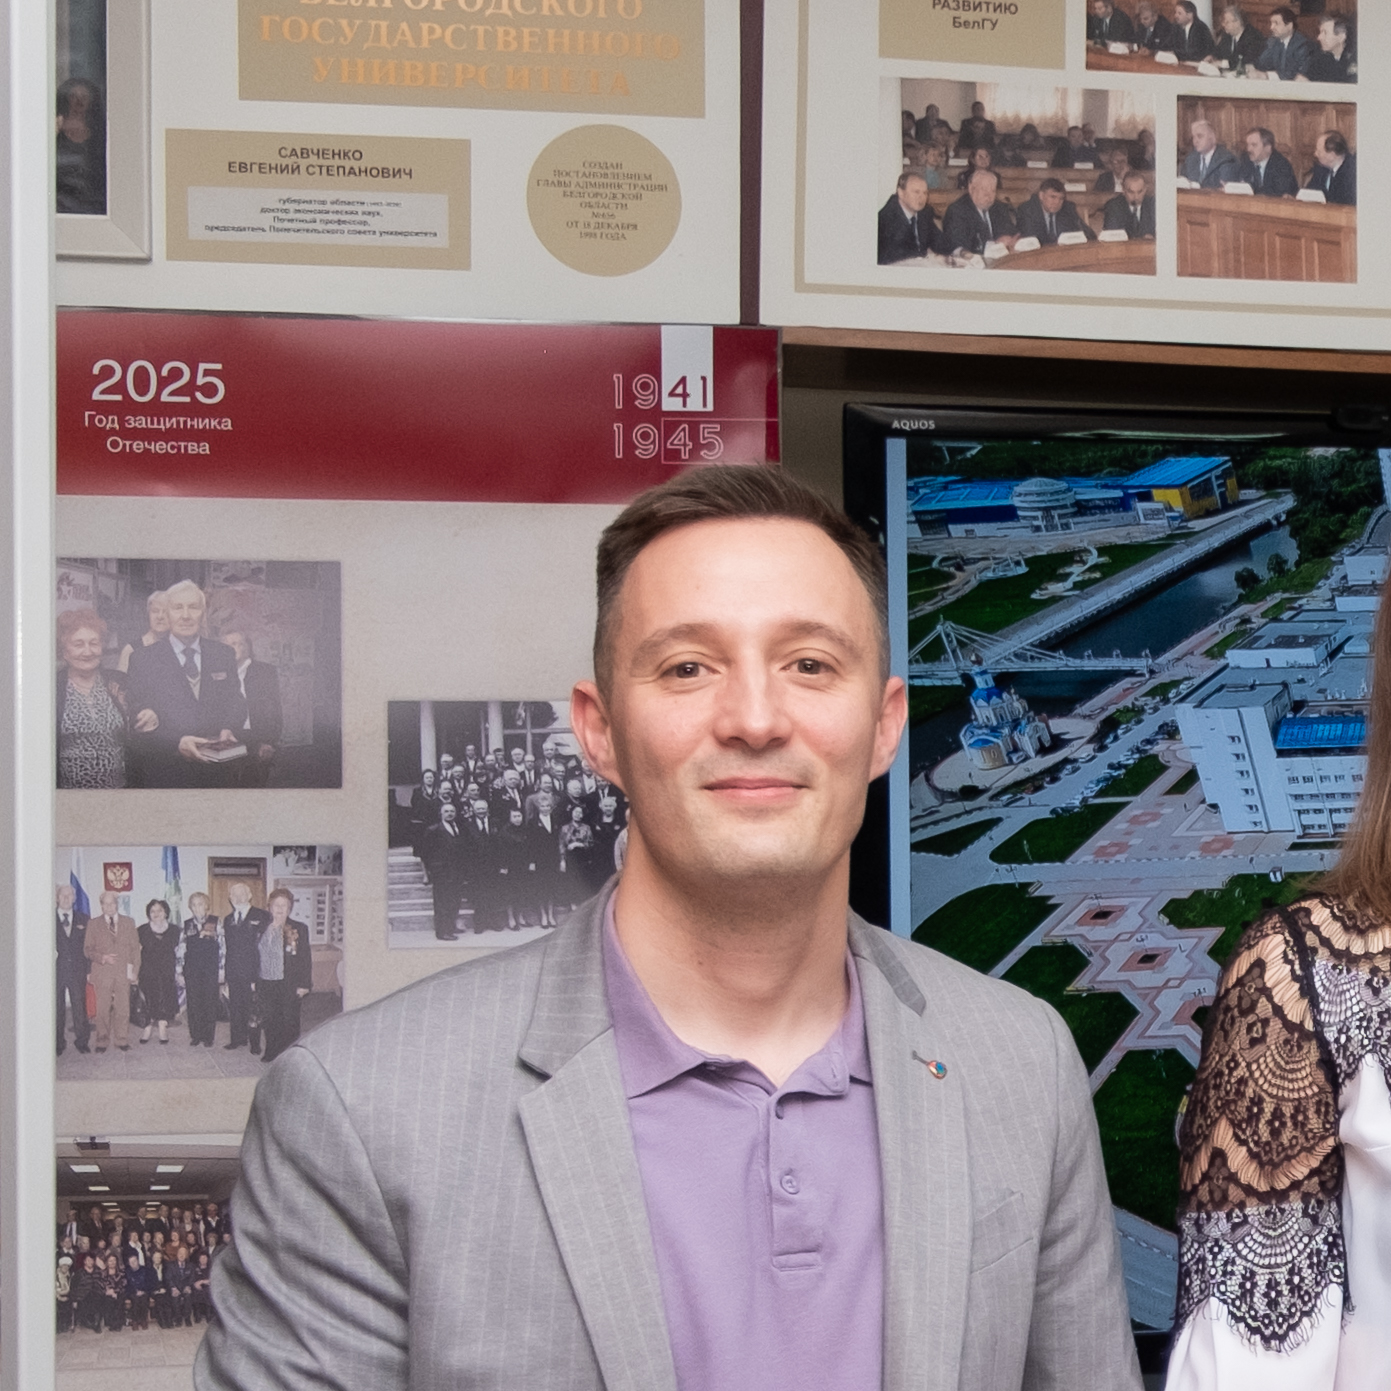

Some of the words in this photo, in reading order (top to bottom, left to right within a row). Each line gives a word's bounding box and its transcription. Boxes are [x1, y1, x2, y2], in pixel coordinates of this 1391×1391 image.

[932, 0, 1018, 15] РАЗВИТИЮ
[952, 16, 998, 31] БелГУ
[260, 15, 681, 61] ГОСУДАРСТВЕННОГО
[313, 57, 632, 97] УНИВЕРСИТЕТА
[278, 146, 363, 161] САВЧЕНКО
[228, 161, 301, 176] ЕВГЕНИЙ
[306, 164, 413, 180] СТЕПАНОВИЧ
[92, 359, 226, 404] 2025
[613, 373, 709, 409] 1941
[84, 411, 120, 430] Год
[125, 415, 233, 432] защитника
[891, 419, 936, 431] AQUOS
[106, 436, 210, 455] Отечества
[613, 423, 724, 460] 1945
